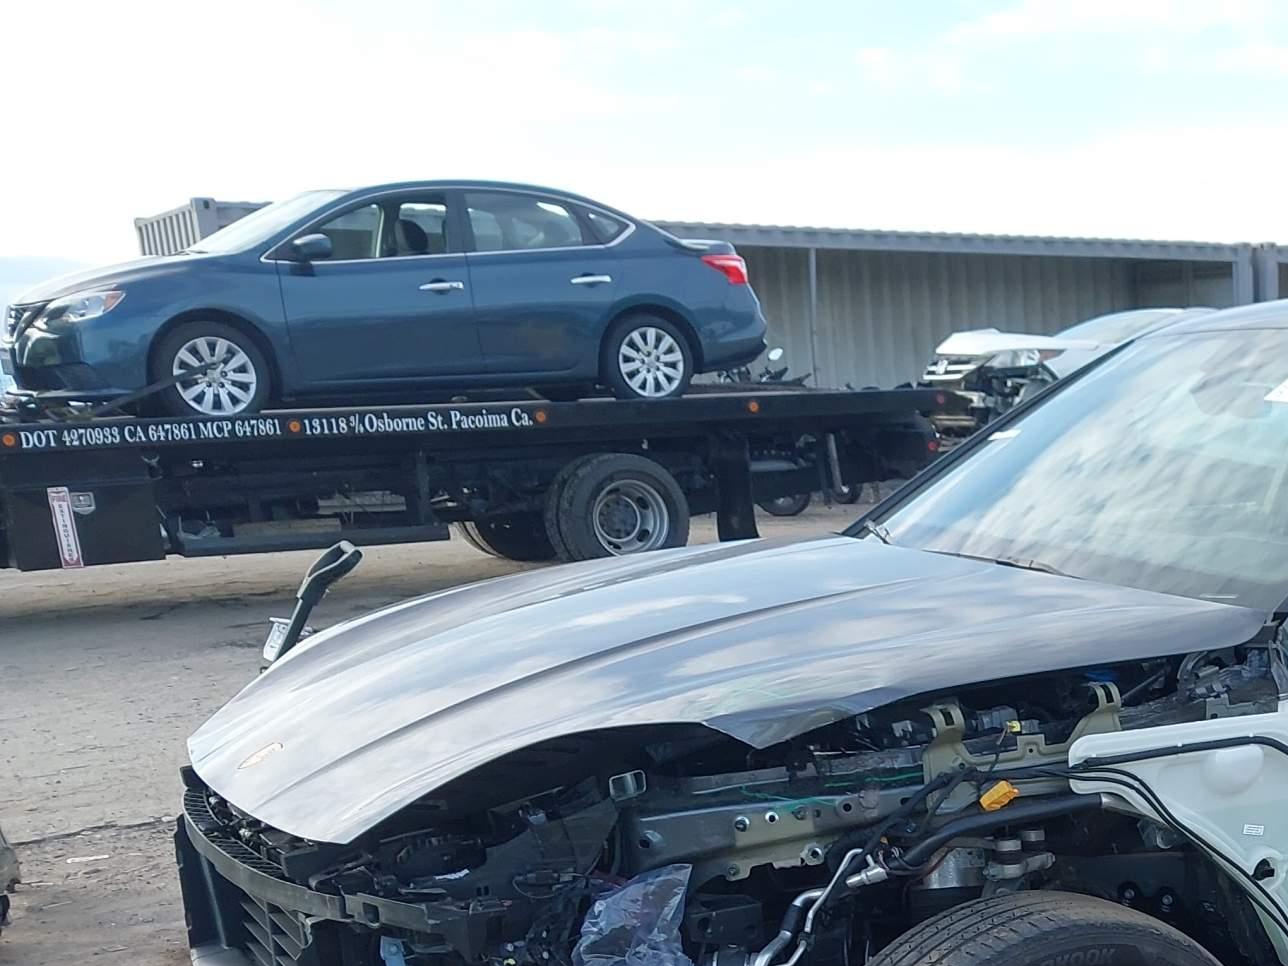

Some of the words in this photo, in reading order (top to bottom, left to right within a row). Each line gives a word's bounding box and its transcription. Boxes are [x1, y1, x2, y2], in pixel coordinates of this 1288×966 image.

[20, 430, 57, 448] DOT
[124, 425, 146, 443] CA
[148, 423, 196, 442] 647861
[198, 421, 232, 439] MCP
[235, 419, 282, 437] 647861
[303, 417, 348, 435] 13118
[364, 412, 425, 433] Osborne
[427, 411, 448, 430] St.
[450, 409, 509, 430] Pacoima
[511, 407, 534, 426] Ca.
